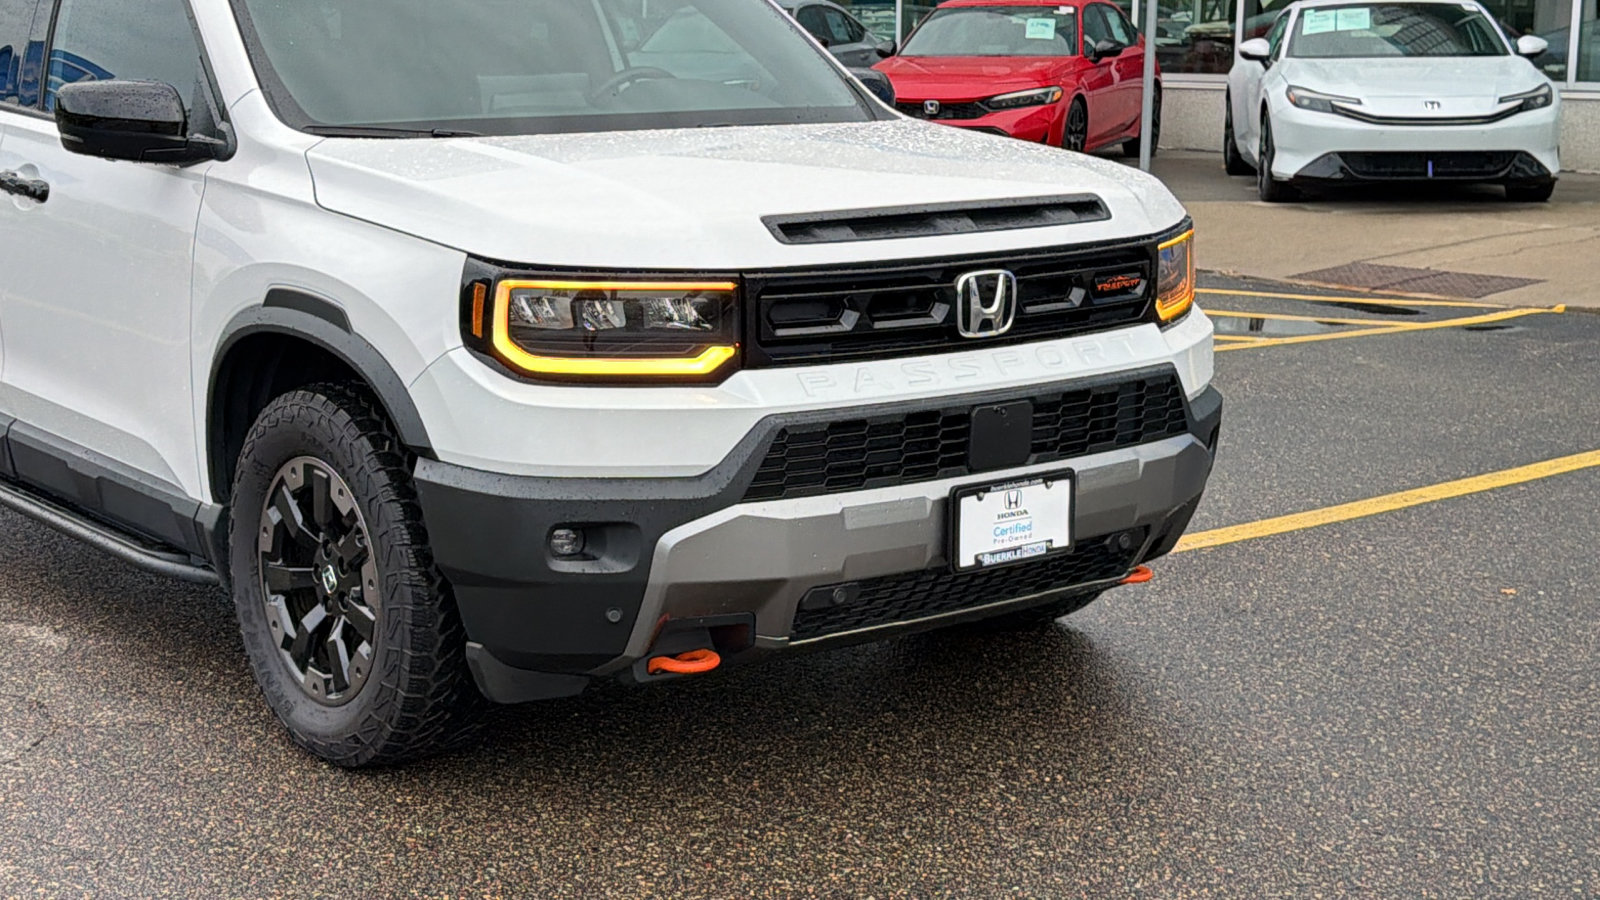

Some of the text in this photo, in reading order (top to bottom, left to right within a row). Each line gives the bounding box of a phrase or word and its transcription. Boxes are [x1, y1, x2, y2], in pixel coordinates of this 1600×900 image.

[796, 334, 1137, 397] PASSPORT
[997, 509, 1029, 520] HONDA
[993, 520, 1033, 537] Certified
[993, 532, 1033, 545] Pre-Owned
